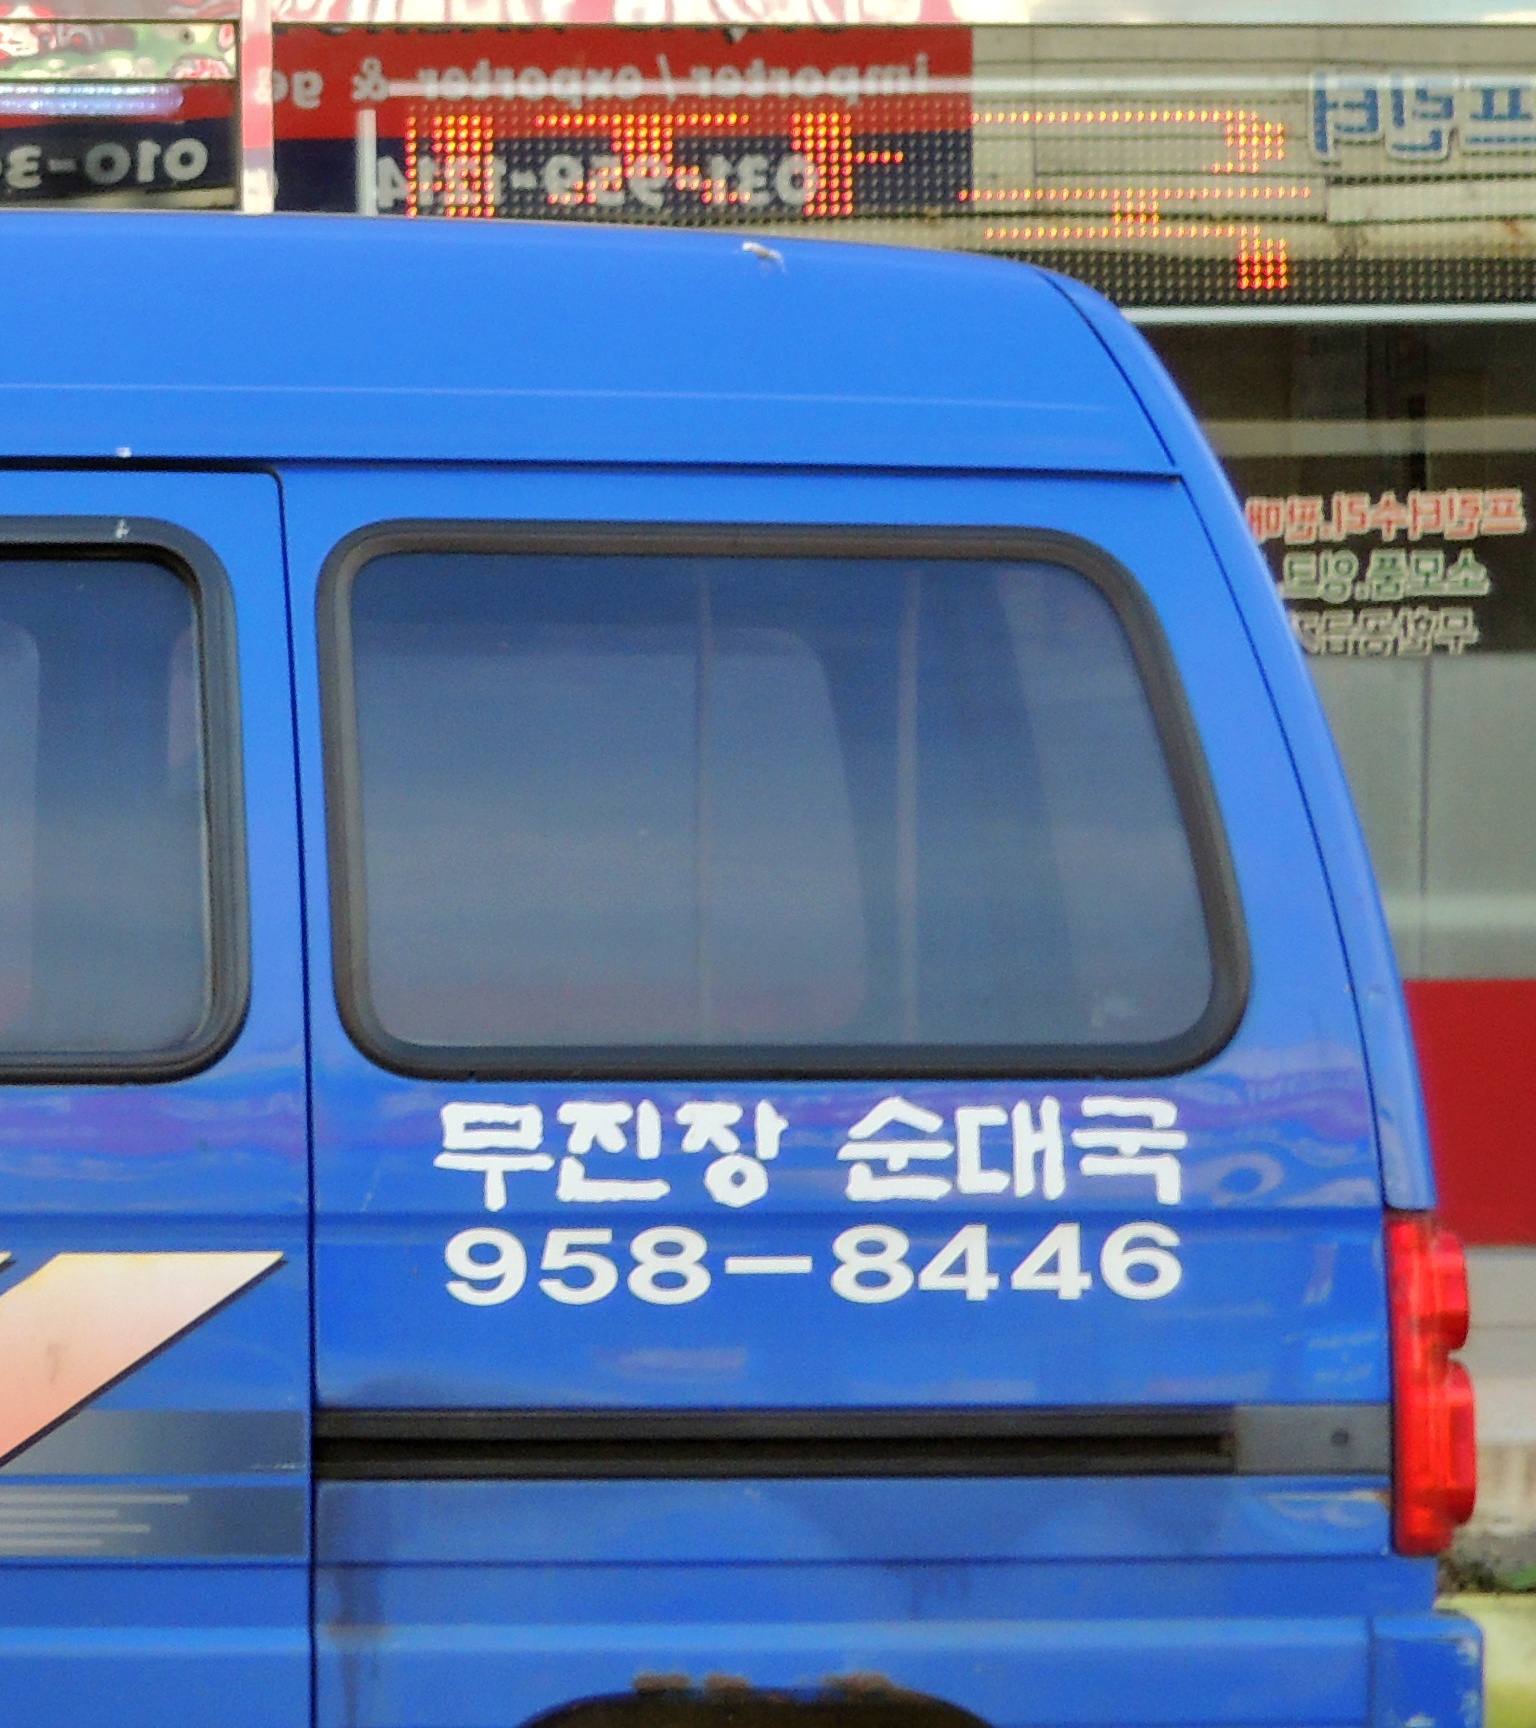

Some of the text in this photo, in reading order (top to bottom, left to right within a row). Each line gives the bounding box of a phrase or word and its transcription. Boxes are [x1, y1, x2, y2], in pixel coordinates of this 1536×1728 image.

[433, 1095, 1190, 1212] 무진장 순대국
[444, 1222, 1183, 1308] 958-8446
